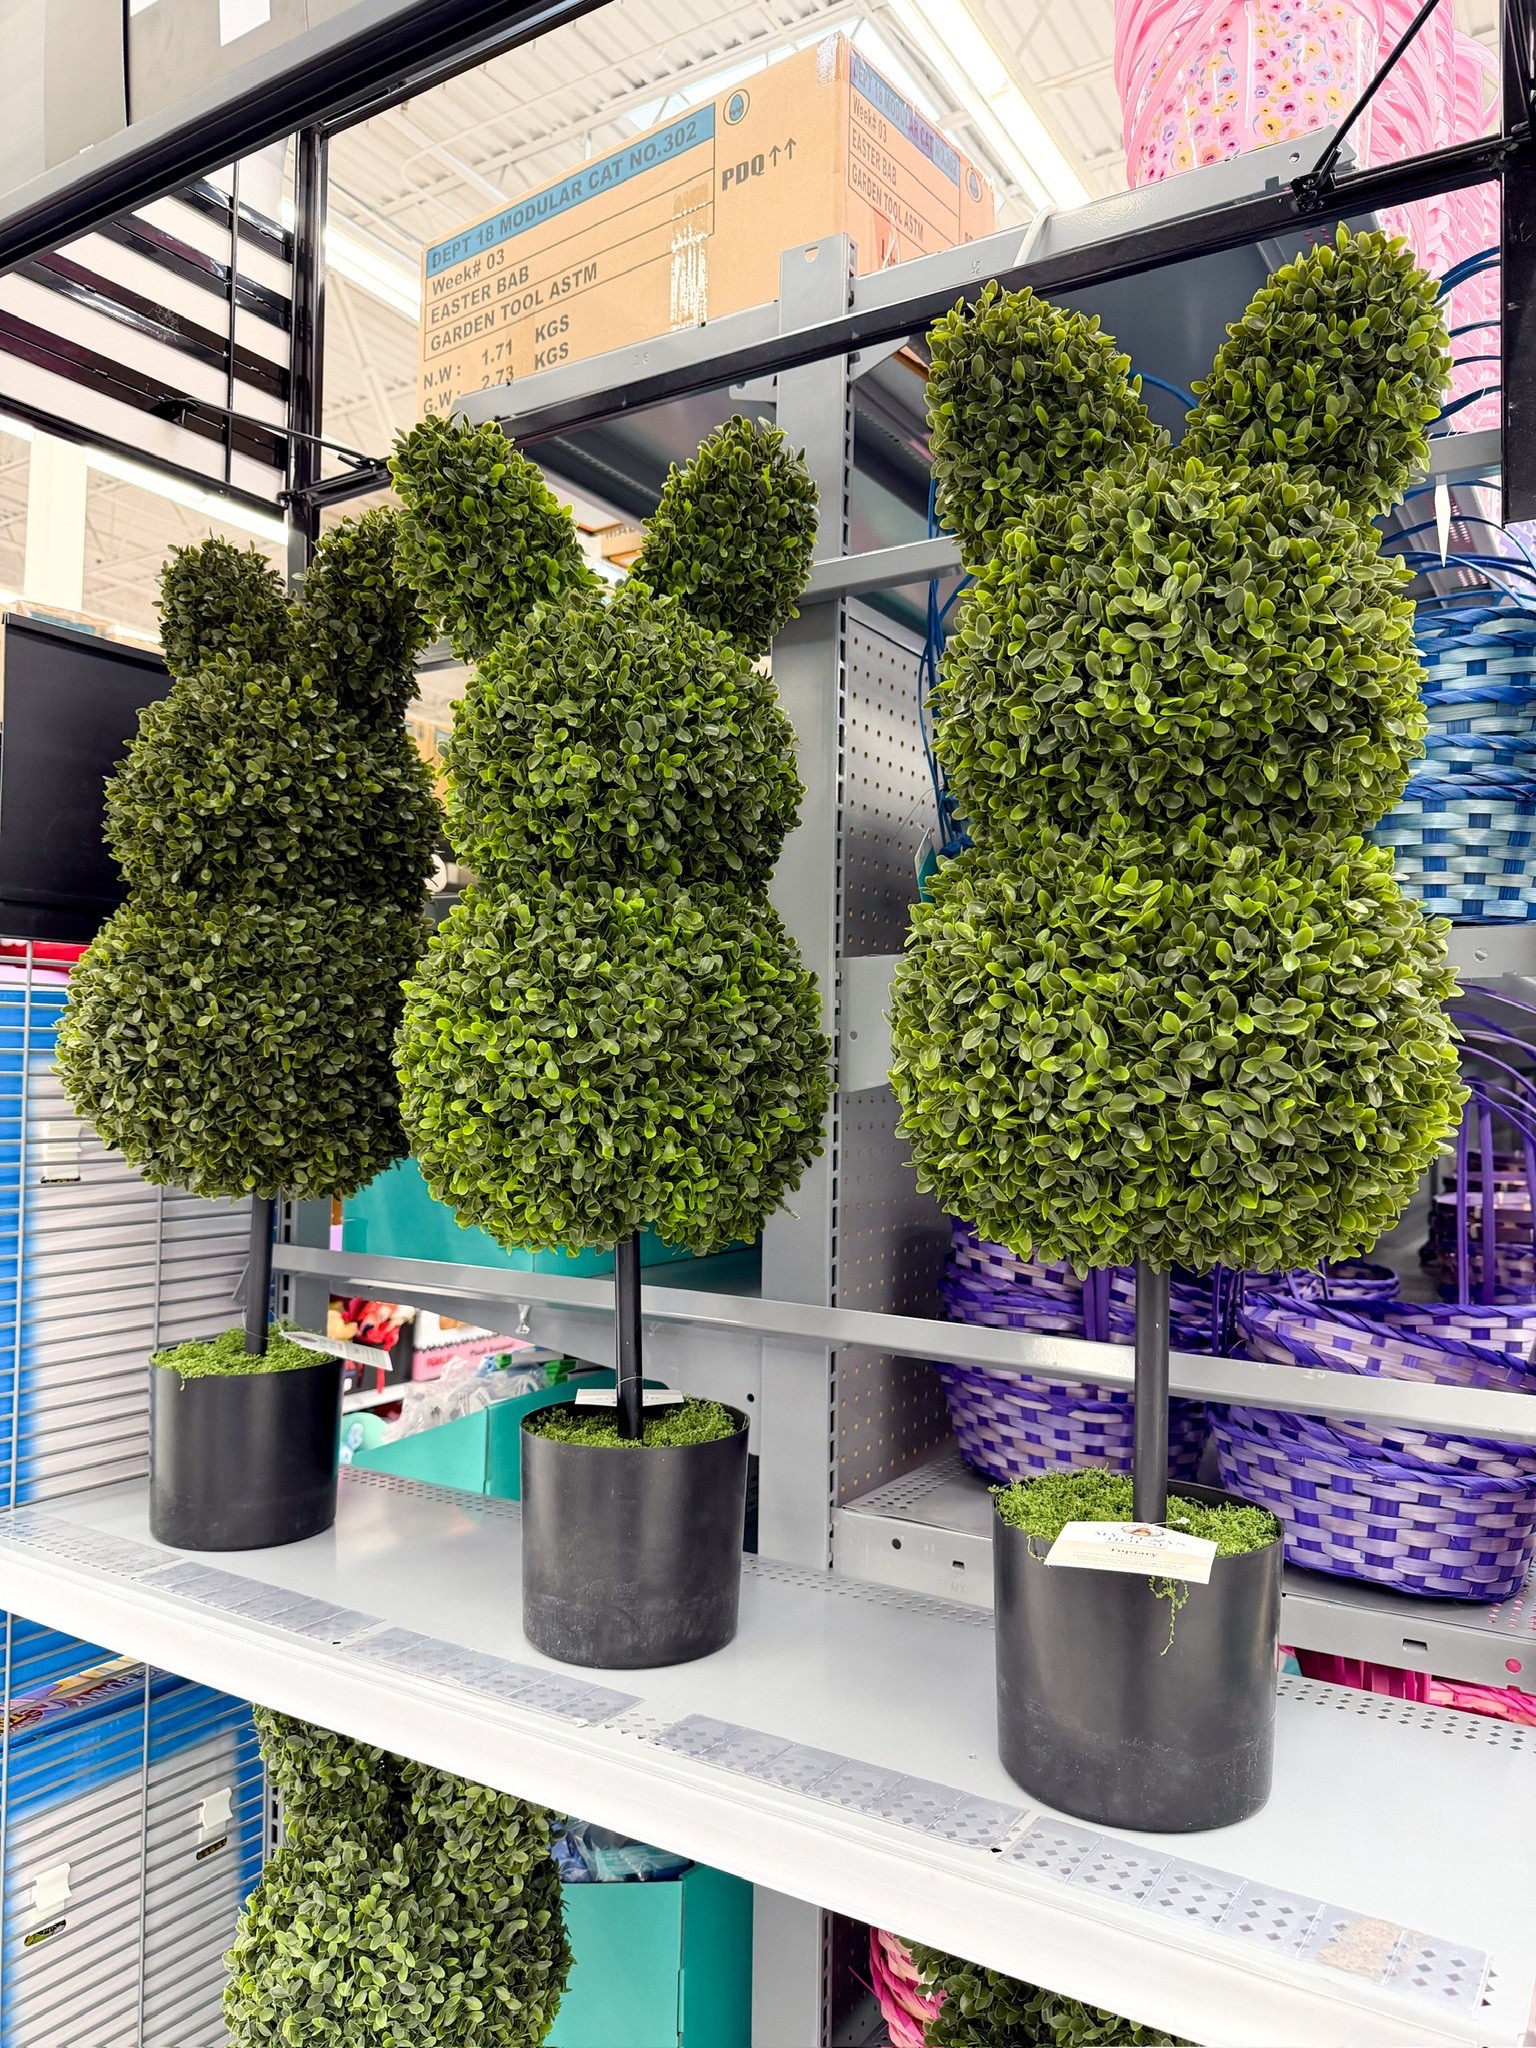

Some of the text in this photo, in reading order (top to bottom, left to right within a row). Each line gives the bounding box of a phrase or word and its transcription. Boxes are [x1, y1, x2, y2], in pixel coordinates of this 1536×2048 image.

[853, 94, 888, 143] Week# 03
[920, 127, 934, 153] CAT
[721, 153, 765, 191] PDQ
[852, 127, 897, 186] EASTER BAB
[432, 120, 697, 269] DEPT 18 MODULAR CAT NO.302
[852, 162, 882, 205] GARDEN
[884, 192, 902, 225] TOOL
[904, 210, 924, 242] ASTM
[431, 265, 529, 324] EASTER BAB
[432, 248, 505, 296] Week# 03
[431, 262, 598, 351] GARDEN TOOL ASTM
[481, 339, 513, 366] 1.71
[535, 314, 570, 343] KGS
[482, 365, 514, 389] 2.73
[534, 342, 569, 370] KGS
[72, 1676, 140, 1707] BUNNY
